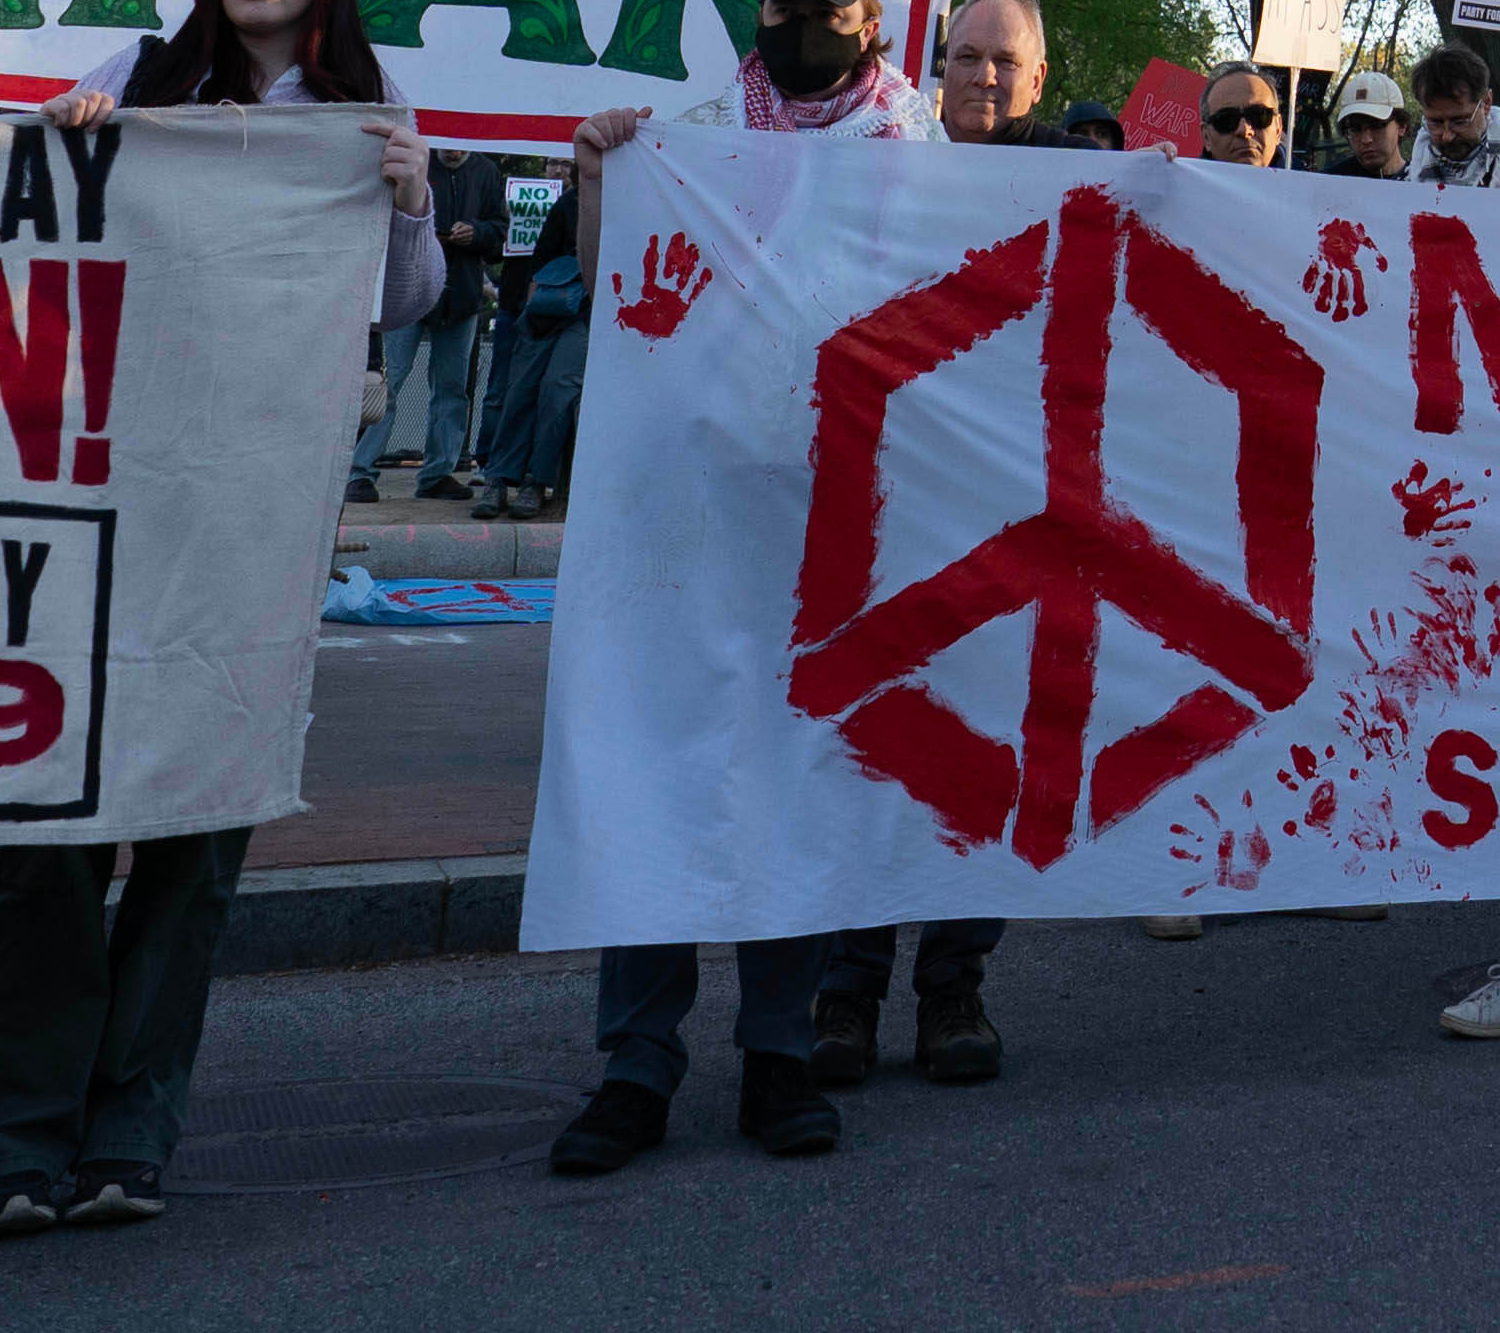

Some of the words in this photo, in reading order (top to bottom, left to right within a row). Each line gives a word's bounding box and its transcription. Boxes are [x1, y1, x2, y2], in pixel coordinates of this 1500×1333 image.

[1460, 5, 1485, 21] PARTY
[1139, 92, 1198, 138] WAR
[518, 187, 550, 201] NO
[511, 228, 540, 246] IRA
